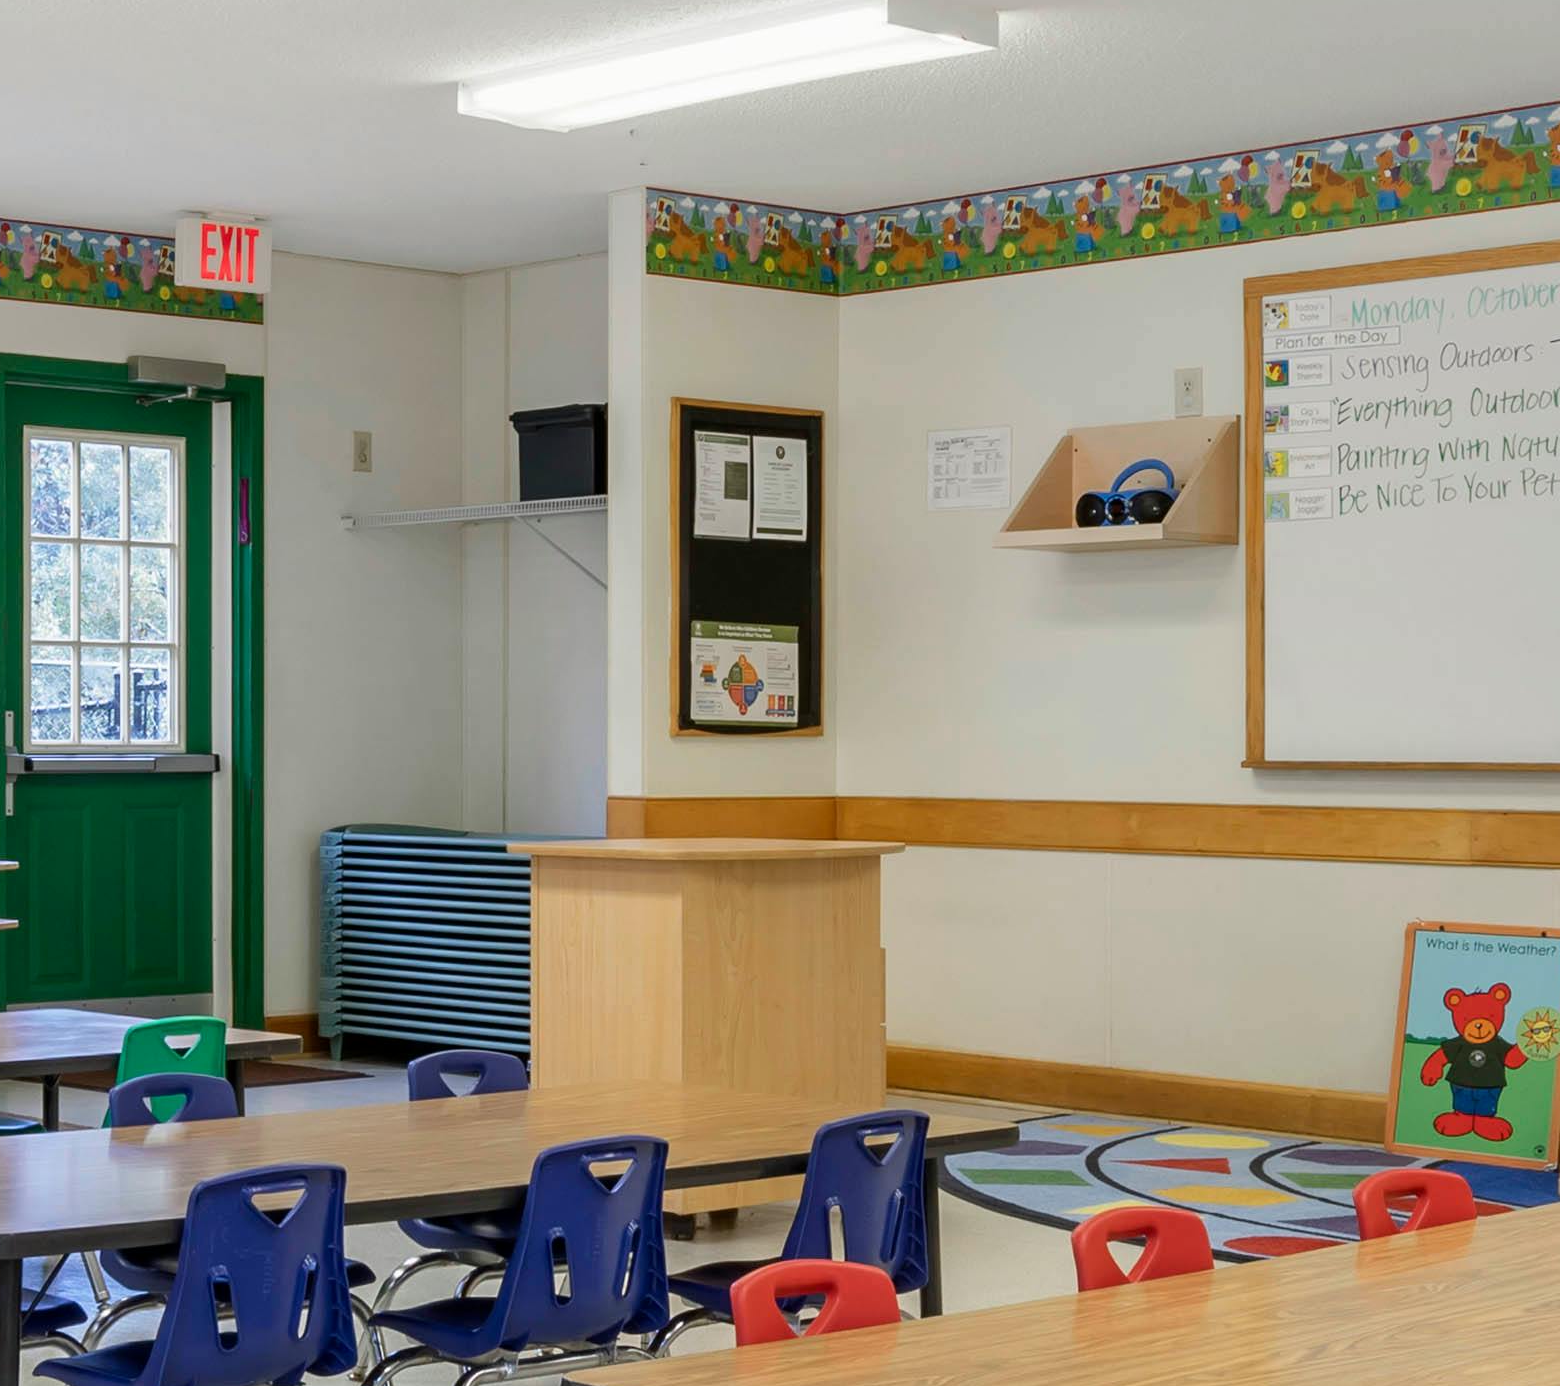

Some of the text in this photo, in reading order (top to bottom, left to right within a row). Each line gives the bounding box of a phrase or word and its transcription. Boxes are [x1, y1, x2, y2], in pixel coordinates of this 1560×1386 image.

[200, 223, 259, 283] EXIT
[1275, 329, 1388, 350] Plan for the Day
[1341, 353, 1430, 392] Sensing
[1338, 443, 1430, 479] Painting
[1438, 439, 1490, 464] With
[1339, 484, 1368, 515] Be
[1377, 481, 1426, 511] Nice
[1431, 474, 1457, 503] To
[1464, 471, 1512, 500] Your
[1426, 937, 1557, 957] What is the Weather?
